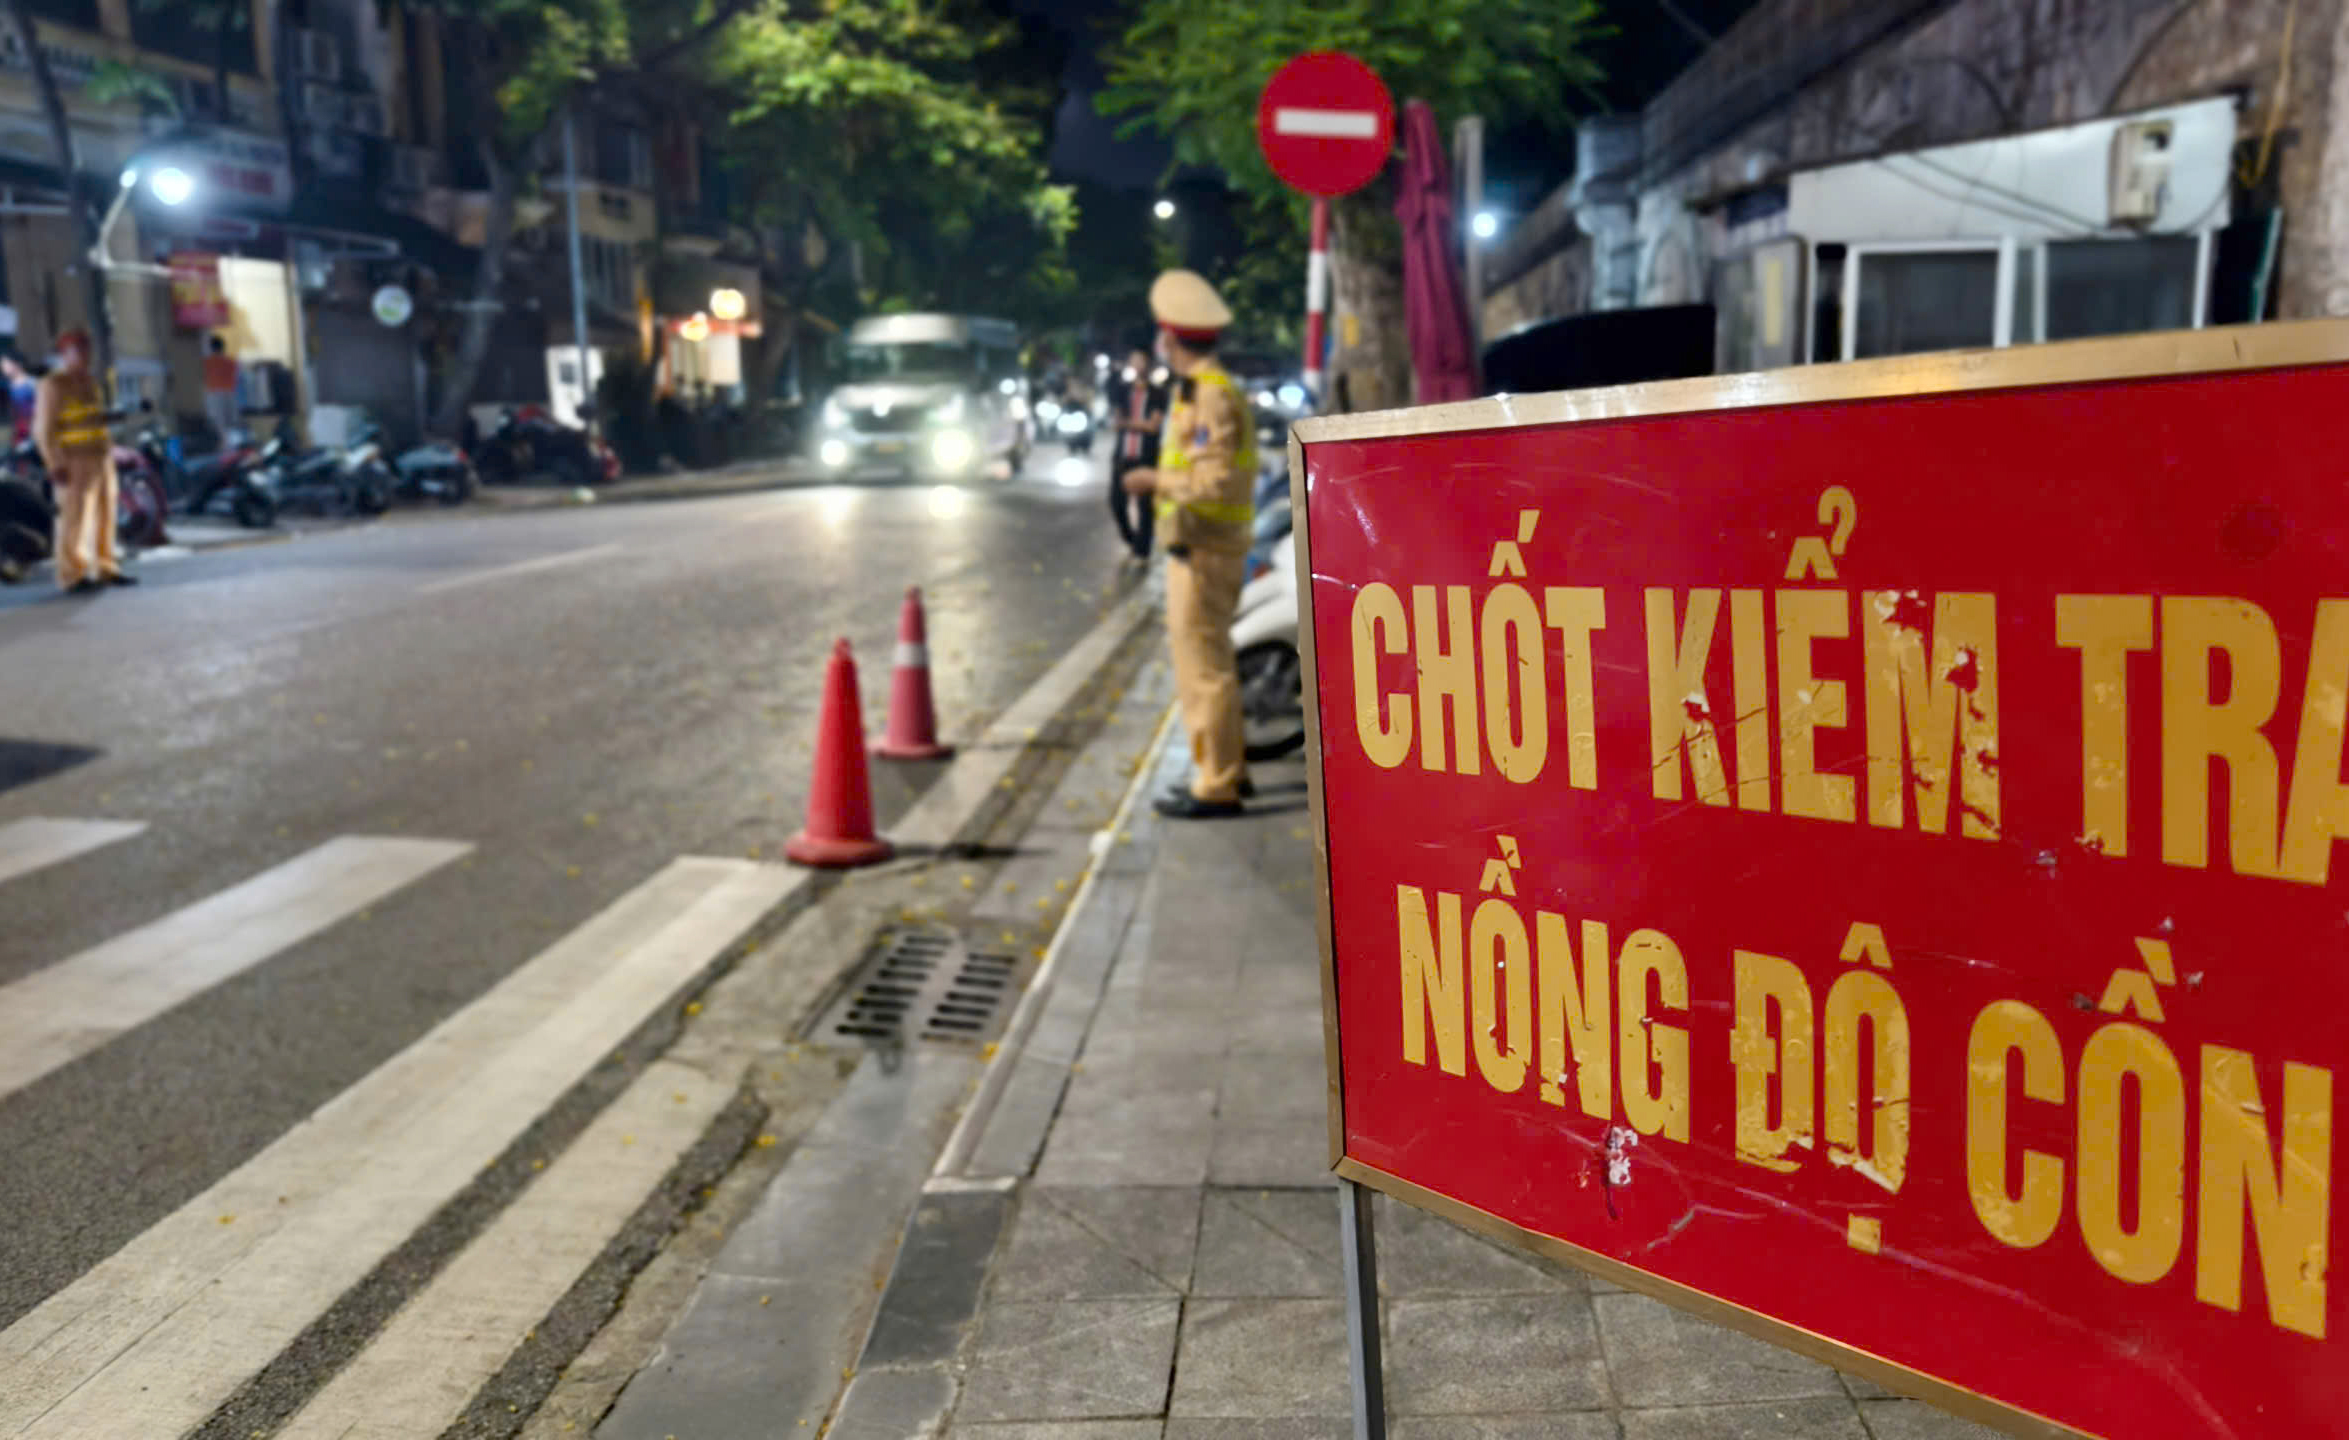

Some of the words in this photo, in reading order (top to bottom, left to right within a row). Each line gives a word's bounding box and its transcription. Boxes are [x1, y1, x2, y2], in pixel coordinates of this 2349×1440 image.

[1350, 509, 1607, 791] CHỐT
[1644, 487, 2000, 842] KIỂM
[1396, 834, 1690, 1145] NỒNG
[1729, 922, 1910, 1254] ĐỘ
[1966, 937, 2333, 1340] CỒN
